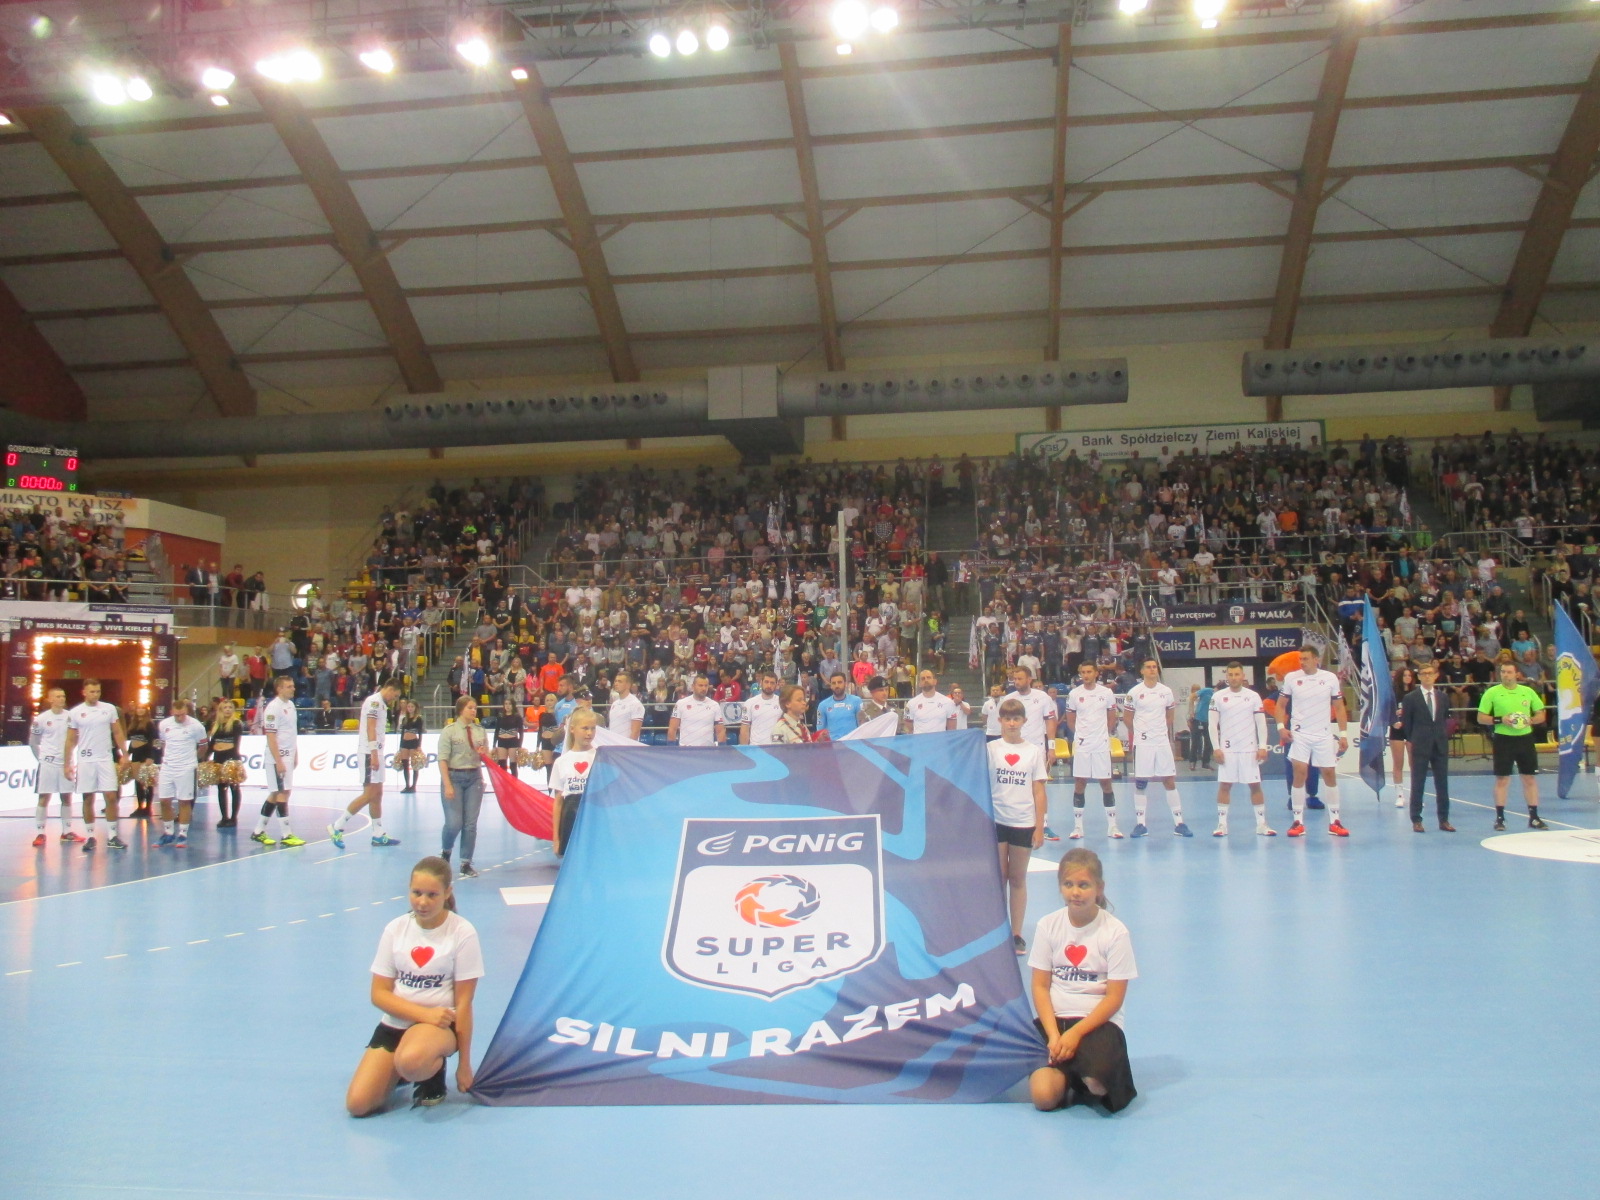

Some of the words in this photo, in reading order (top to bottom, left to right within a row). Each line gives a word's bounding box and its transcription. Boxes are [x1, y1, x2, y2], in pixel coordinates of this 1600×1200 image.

[1081, 435, 1113, 447] Bank
[1120, 431, 1198, 447] Spółdzielczy
[1205, 428, 1240, 441] Ziemi
[1247, 426, 1301, 440] Kaliskiej
[8, 444, 51, 455] GOSPODARZE
[7, 453, 17, 466] 0
[67, 458, 77, 471] 0
[1257, 609, 1294, 620] WALKA
[56, 623, 86, 631] KALISZ
[1155, 639, 1192, 652] Kalisz
[1198, 636, 1254, 651] ARENA
[1260, 635, 1296, 648] Kalisz
[1078, 738, 1085, 746] 7
[1141, 732, 1147, 741] 5
[1224, 740, 1231, 749] 3
[995, 767, 1028, 778] Zdrowy
[567, 776, 587, 785] Zdro
[996, 775, 1026, 786] Kalisz
[742, 831, 865, 854] PGNiG
[696, 931, 852, 957] SUPER
[716, 956, 828, 975] LIGA
[547, 1015, 730, 1059] SILNI
[749, 982, 977, 1058] RAZEM
